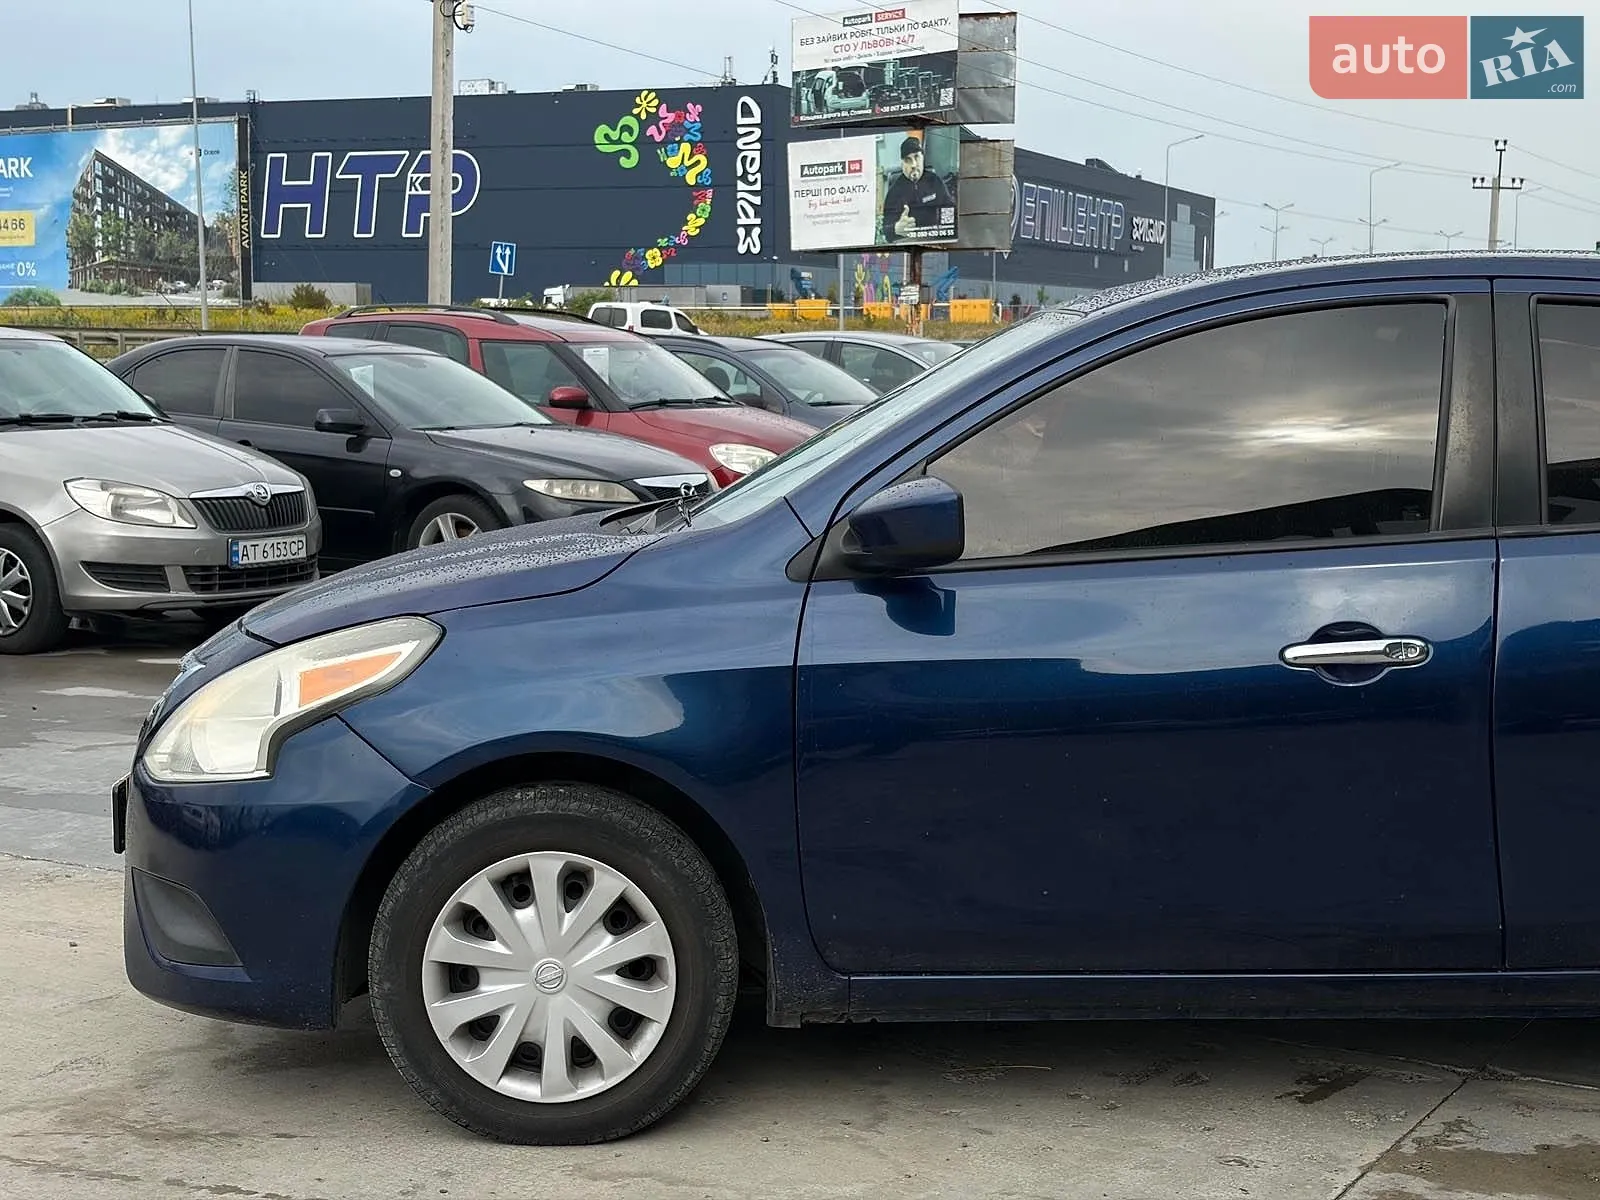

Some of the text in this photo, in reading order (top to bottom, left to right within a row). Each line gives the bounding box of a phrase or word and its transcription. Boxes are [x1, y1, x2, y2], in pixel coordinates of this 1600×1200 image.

[877, 11, 904, 22] SERVICE
[800, 38, 815, 46] БЕЗ
[816, 31, 848, 44] ЗАЙВИХ
[876, 22, 905, 35] ТІЛЬКИ
[906, 22, 920, 32] ПО
[833, 34, 916, 54] СТО У ЛЬВОВІ 24/7
[803, 162, 844, 177] Autopark
[794, 184, 870, 198] ПЕРШІ ПО ФАКТУ.
[239, 170, 250, 249] AVANT PARK
[1020, 182, 1125, 251] ЕПІЦЕНТР
[16, 261, 37, 277] 0%
[241, 540, 305, 562] AT 6153 CP
